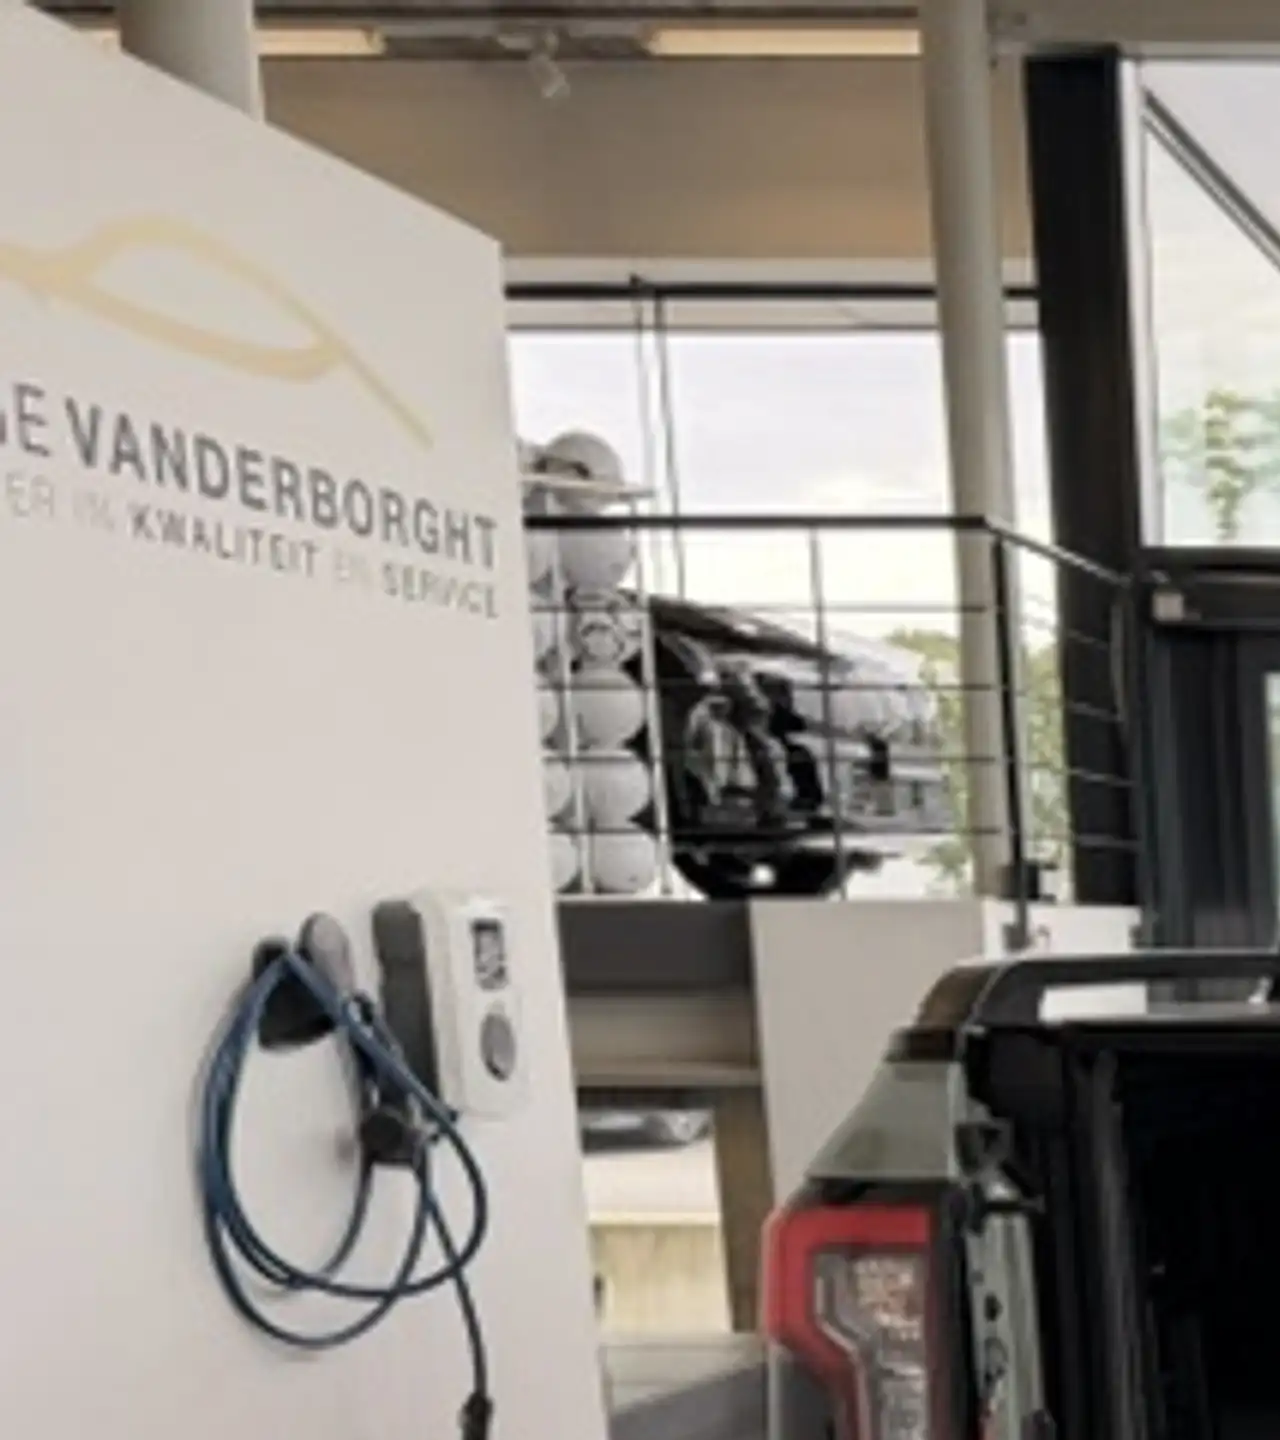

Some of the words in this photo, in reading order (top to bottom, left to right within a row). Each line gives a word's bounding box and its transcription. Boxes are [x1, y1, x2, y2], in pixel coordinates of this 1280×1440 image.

[0, 382, 51, 457] E
[64, 396, 498, 571] VANDERBORGHT
[127, 500, 320, 578] KWALITEIT
